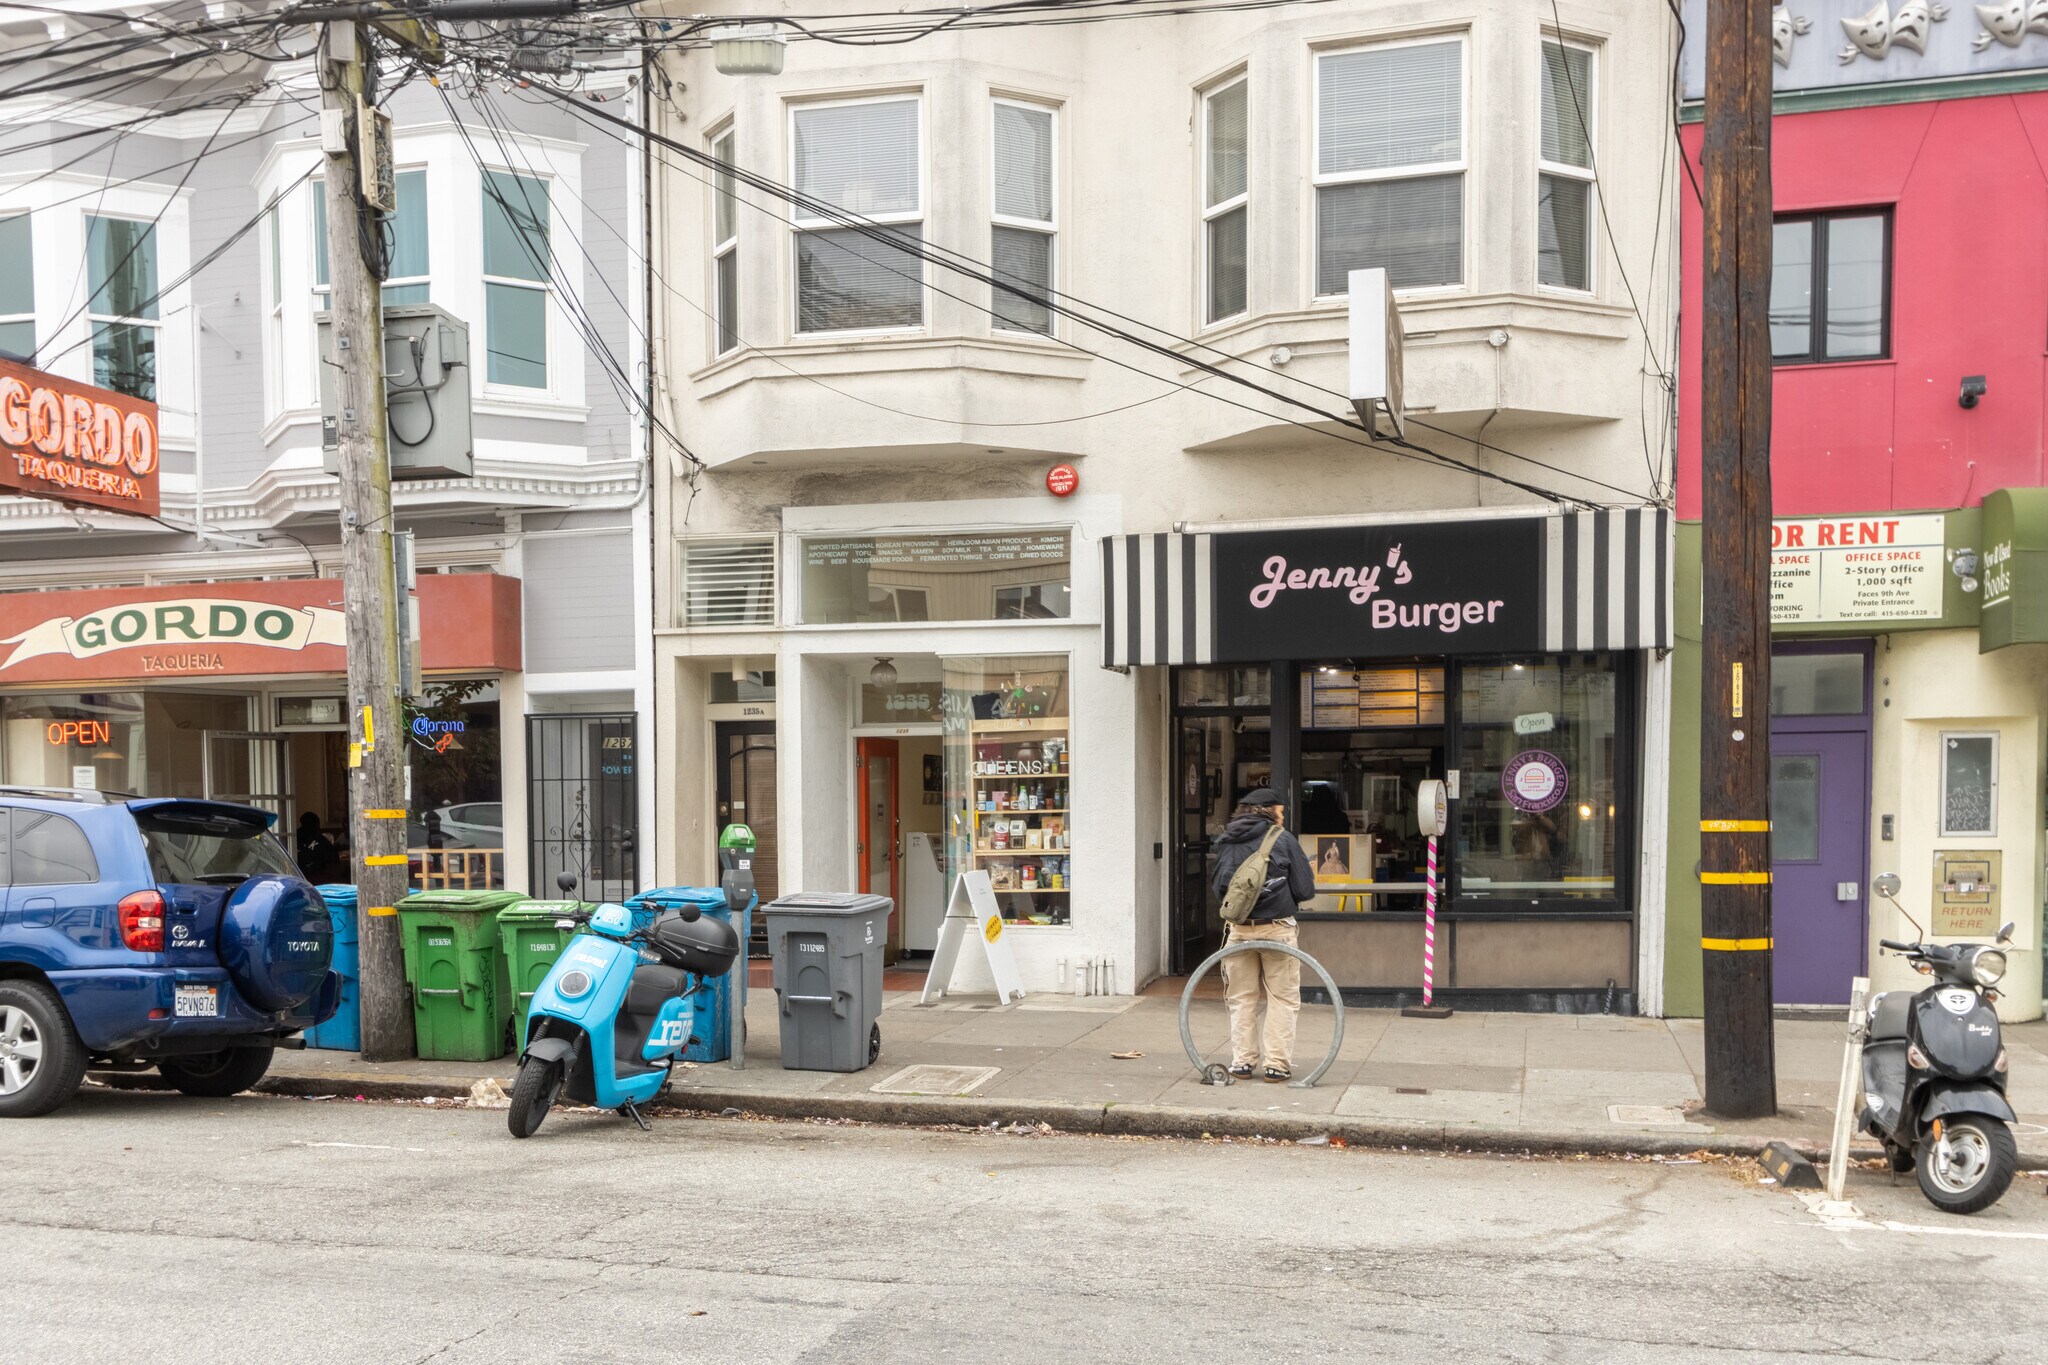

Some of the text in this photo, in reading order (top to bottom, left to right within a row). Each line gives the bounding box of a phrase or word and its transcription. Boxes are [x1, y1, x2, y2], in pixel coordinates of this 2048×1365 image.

[0, 376, 158, 475] GORDO
[12, 453, 142, 499] TAQUERIA
[1817, 520, 1900, 546] RENT
[808, 543, 840, 551] IMPORTED
[840, 542, 875, 550] ARTISANAL
[875, 541, 901, 549] KOREAN
[902, 540, 940, 548] PROVISIONS
[947, 539, 981, 547] HEIRLOOM
[1001, 537, 1033, 545] PRODUCE
[989, 552, 1014, 560] COFFEE
[1778, 555, 1810, 564] SPACE
[1845, 551, 1922, 563] OFFICE SPACE
[1250, 543, 1413, 609] Jenny's
[1770, 567, 1811, 577] zzanine
[1845, 565, 1924, 575] 2-Story Office
[1857, 576, 1913, 587] 1,000 sqft
[1983, 562, 2010, 600] Books
[1896, 589, 1910, 597] Ave
[1372, 599, 1504, 633] Burger
[75, 605, 294, 648] GORDO
[142, 654, 223, 672] TAQUERIA
[413, 717, 465, 736] Corona
[1520, 717, 1546, 731] Open
[48, 720, 109, 745] OPEN
[971, 760, 1042, 778] QUEENS
[1522, 788, 1562, 810] Francisco
[1941, 907, 1993, 916] RETURN
[1949, 919, 1984, 928] HERE
[288, 941, 320, 951] TOYOTA
[177, 997, 215, 1011] 5PVN876
